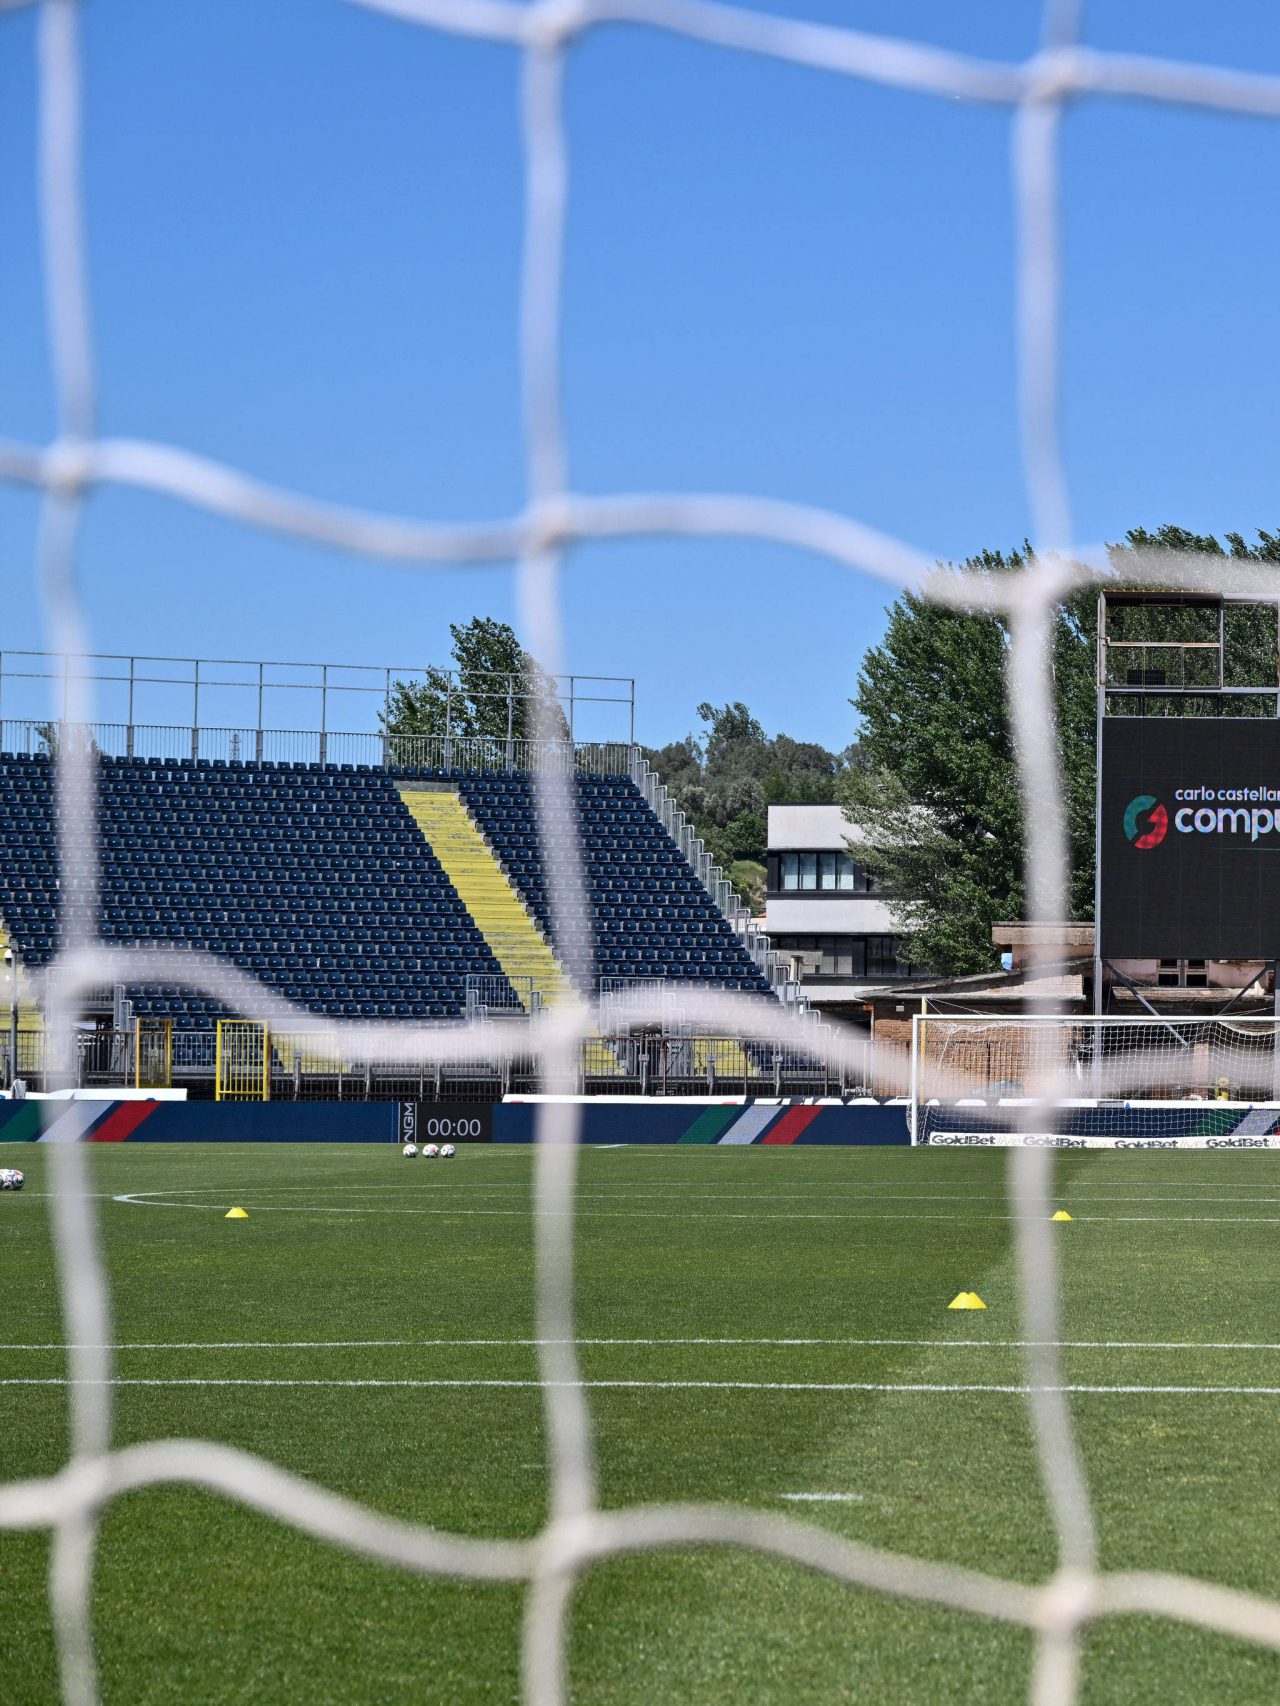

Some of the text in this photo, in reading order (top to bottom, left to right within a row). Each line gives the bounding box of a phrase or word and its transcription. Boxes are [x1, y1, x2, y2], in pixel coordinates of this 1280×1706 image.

[1175, 786, 1215, 801] carlo
[404, 1102, 414, 1143] NGM
[427, 1119, 480, 1136] 00:00
[932, 1135, 995, 1145] GoldBet
[1206, 1138, 1269, 1148] GoldBet
